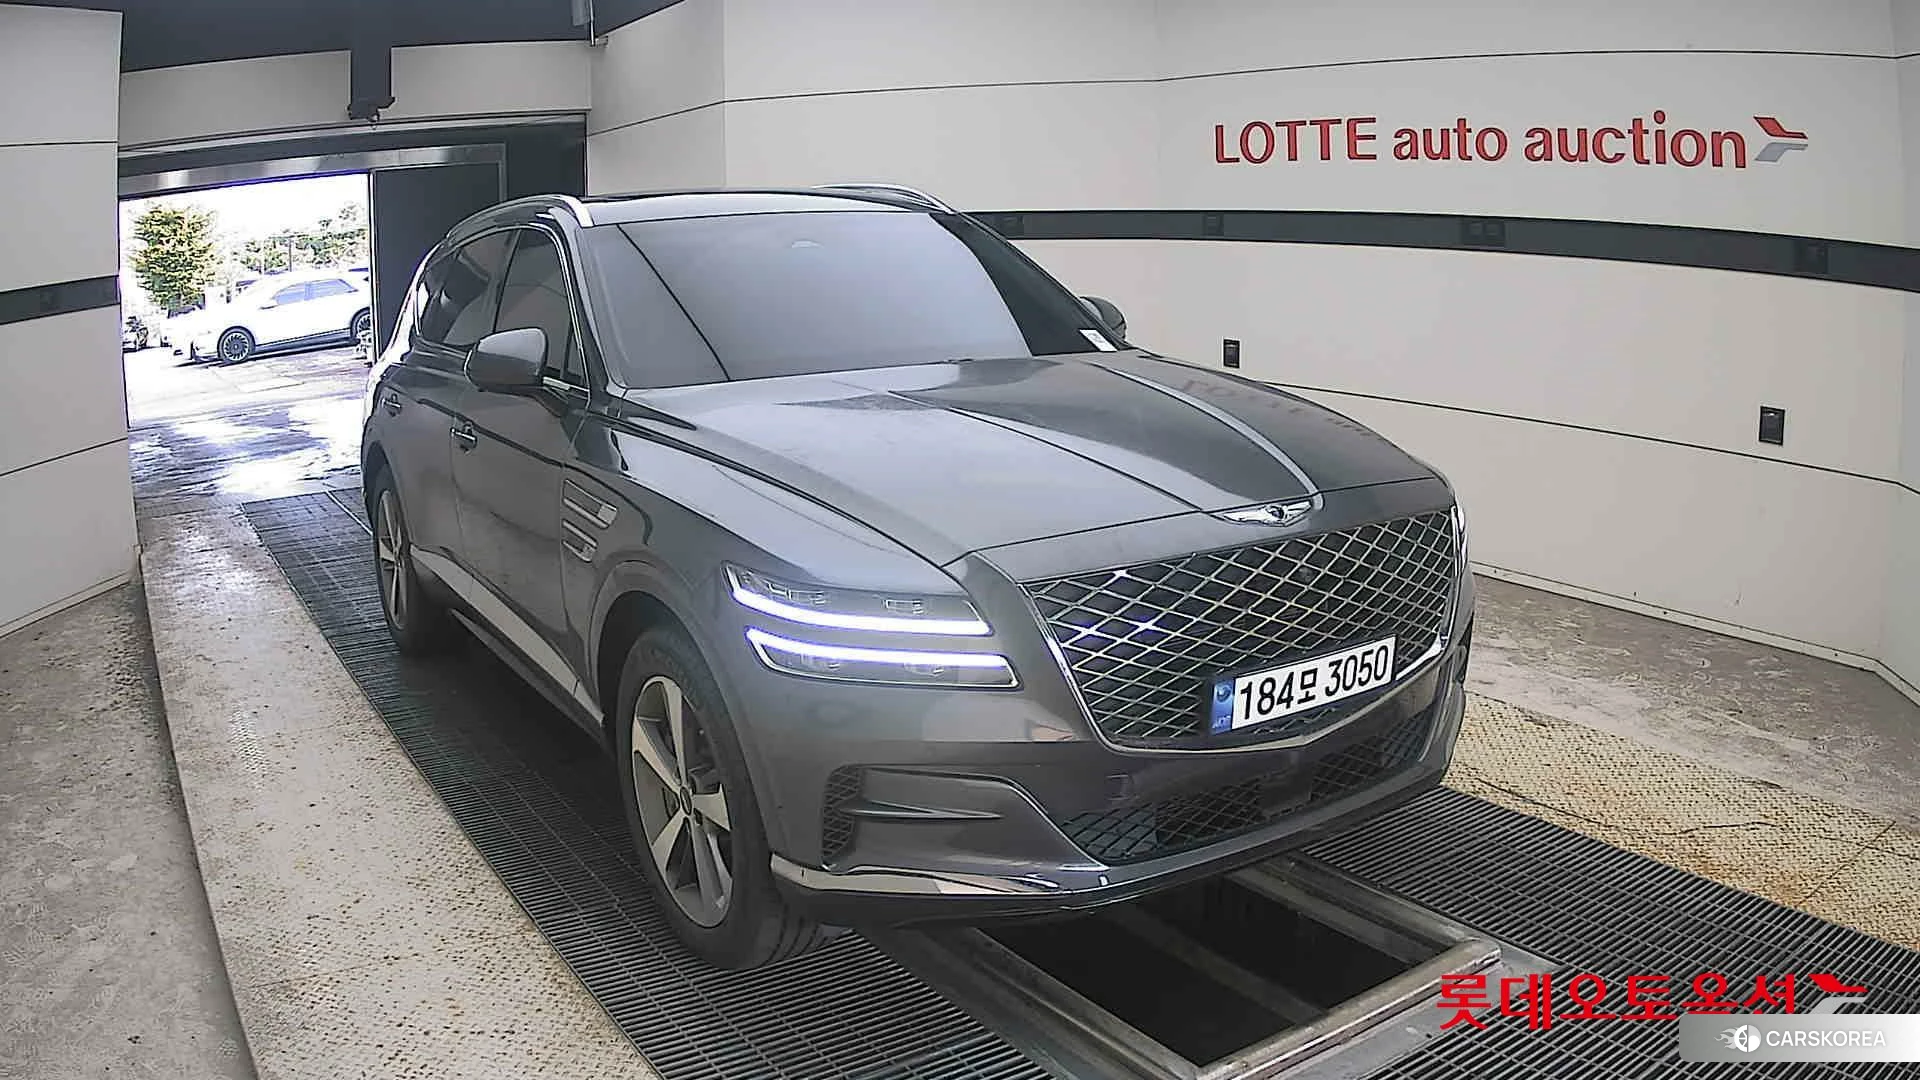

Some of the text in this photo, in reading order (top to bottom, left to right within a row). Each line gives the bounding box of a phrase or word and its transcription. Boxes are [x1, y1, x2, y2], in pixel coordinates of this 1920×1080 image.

[1214, 109, 1747, 168] LOTTE auto auction
[1239, 645, 1389, 720] 184모 3050
